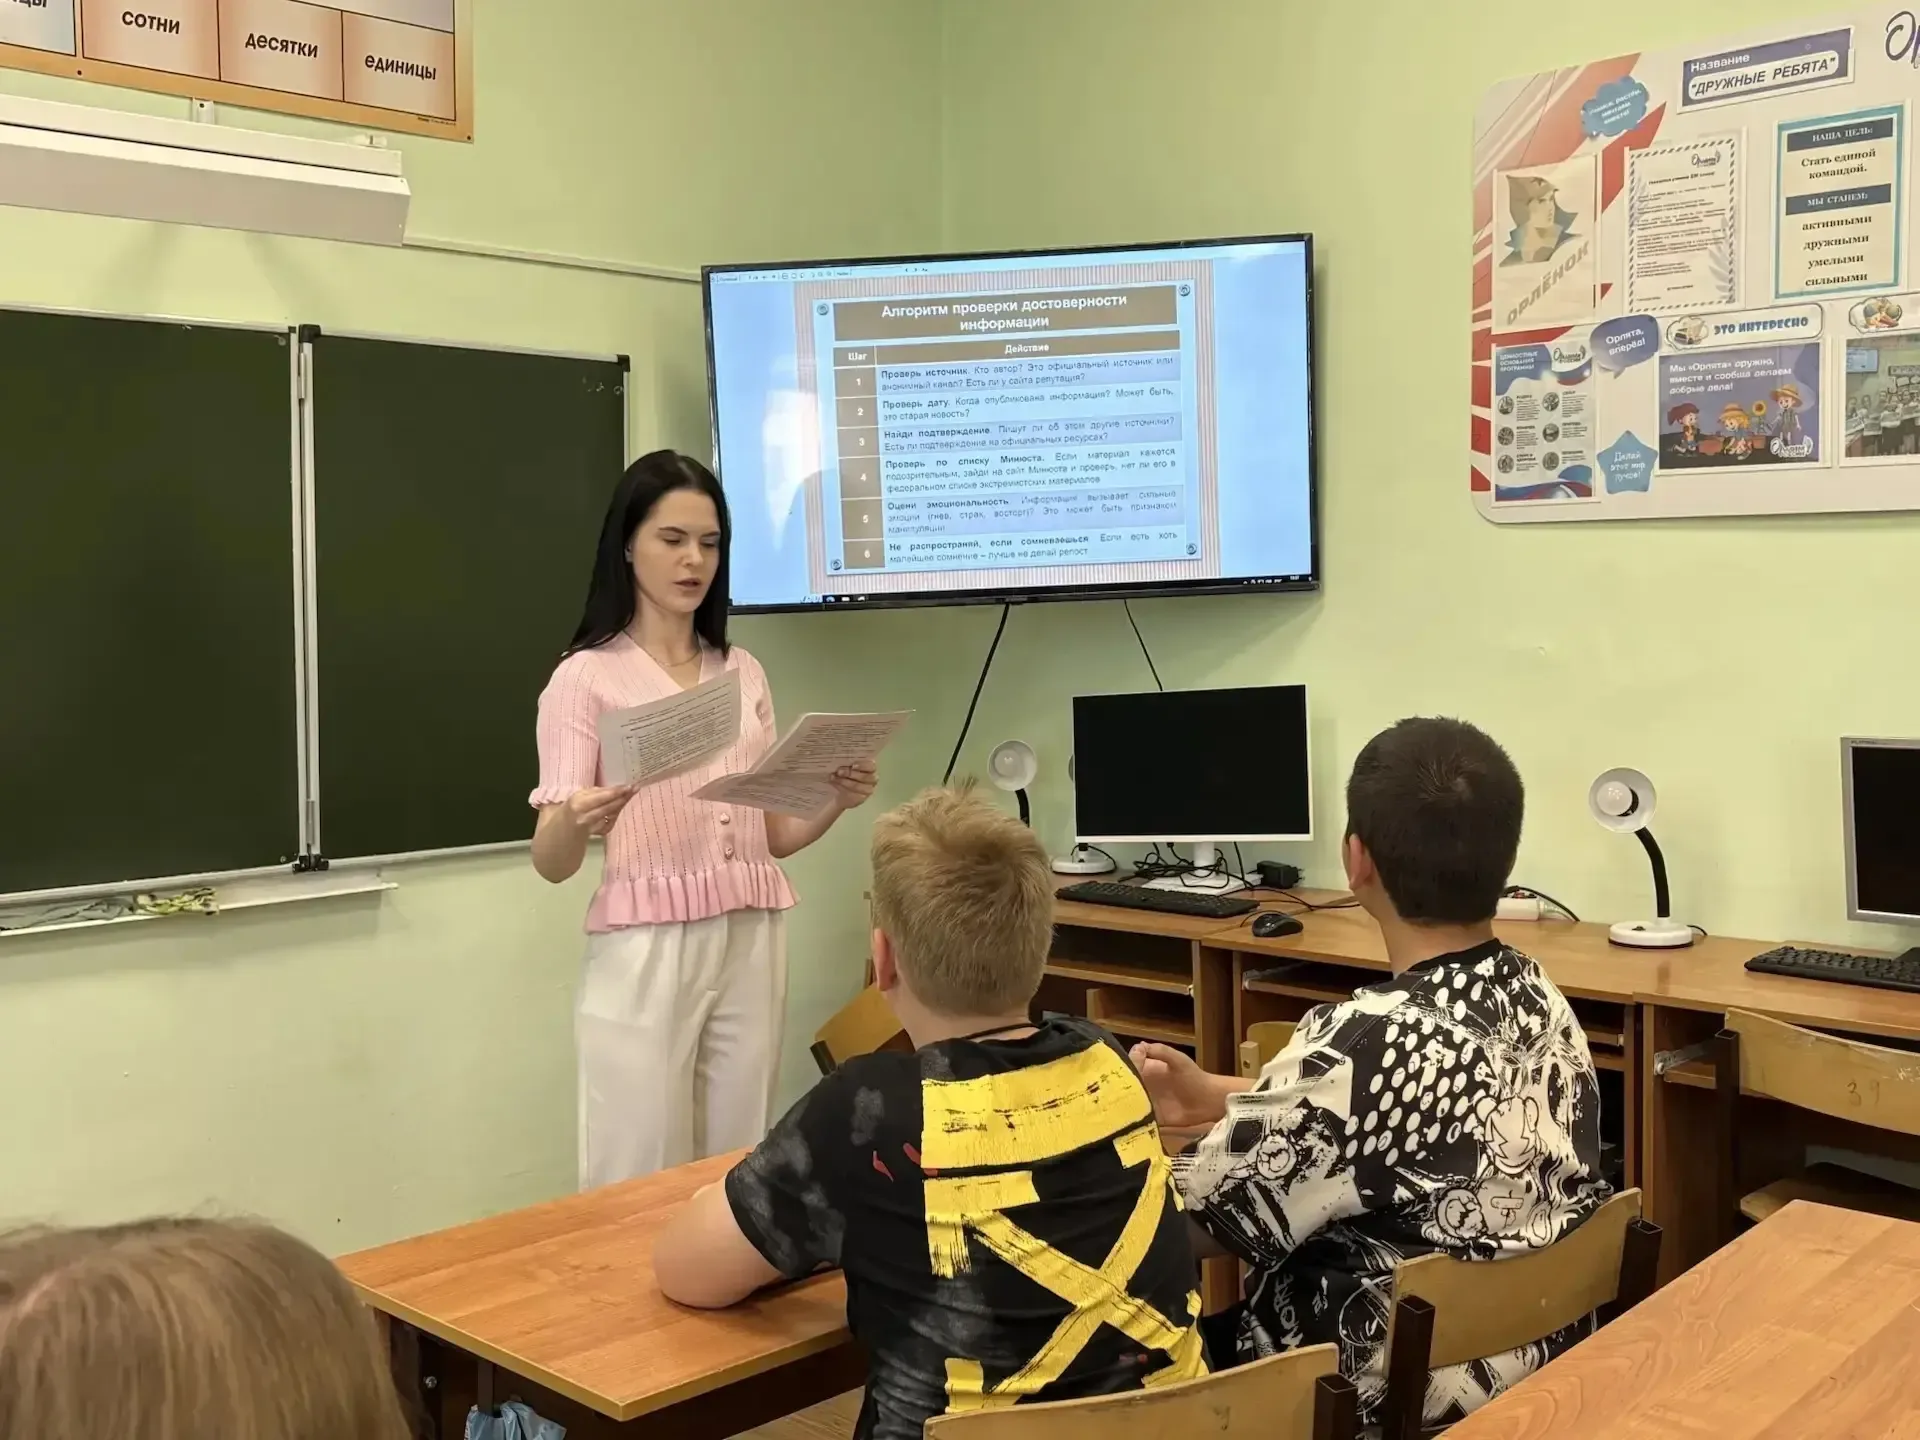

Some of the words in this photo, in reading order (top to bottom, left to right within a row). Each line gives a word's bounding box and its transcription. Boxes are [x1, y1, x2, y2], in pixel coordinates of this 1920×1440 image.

[122, 11, 180, 34] сотни
[245, 32, 318, 59] десятки
[364, 53, 436, 81] единицы
[1691, 54, 1750, 73] Название
[1691, 71, 1766, 96] "ДРУЖНЫЕ
[1772, 57, 1836, 81] РЕБЯТА"
[1812, 130, 1841, 142] НАША
[1801, 154, 1832, 167] Стать
[1834, 149, 1876, 164] единой
[1808, 165, 1868, 180] командой.
[1807, 198, 1824, 207] МЫ
[1802, 214, 1872, 231] активными
[1803, 234, 1869, 251] дружными
[1807, 254, 1864, 270] умелыми
[1507, 241, 1589, 325] ОРЛЁНОК
[1805, 273, 1868, 287] сильными
[881, 303, 948, 319] Алгоритм
[952, 301, 1018, 317] проверки
[1021, 294, 1127, 312] достоверности
[959, 315, 1049, 333] информации
[1713, 324, 1736, 335] ЭТО
[1738, 316, 1809, 333] ИНТЕРЕСНО
[1605, 328, 1645, 345] Орлята,
[848, 351, 867, 361] Шаг
[1004, 343, 1049, 355] Действие
[1608, 338, 1646, 357] вперёд!
[881, 371, 921, 379] Проверь
[993, 364, 1022, 373] автор?
[1027, 363, 1043, 371] Это
[1047, 359, 1109, 371] официальный
[1669, 363, 1686, 373] Мы
[881, 381, 930, 391] анонимный
[933, 379, 963, 388] канал?
[1008, 376, 1032, 384] сайта
[1035, 373, 1085, 384] репутация?
[1669, 374, 1704, 384] вместе
[1705, 374, 1712, 382] и
[882, 401, 922, 410] Проверь
[955, 397, 979, 405] Когда
[984, 395, 1044, 404] опубликована
[1049, 390, 1110, 401] информация?
[857, 407, 863, 415] 2
[899, 412, 929, 420] старая
[931, 409, 969, 418] новость?
[884, 431, 912, 439] Найди
[998, 425, 1025, 433] Пишут
[1048, 422, 1059, 430] об
[1090, 421, 1119, 429] другие
[1124, 417, 1174, 426] источники?
[859, 437, 864, 445] 3
[919, 440, 986, 450] подтверждение
[1002, 436, 1061, 446] официальных
[1064, 432, 1107, 443] ресурсах?
[885, 461, 925, 469] Проверь
[1055, 452, 1076, 460] Если
[860, 473, 866, 481] 4
[963, 469, 988, 477] зайди
[1005, 466, 1024, 474] сайт
[886, 484, 945, 493] федеральном
[887, 502, 916, 511] Оцени
[1020, 495, 1077, 504] Информация
[1087, 492, 1128, 500] вызывает
[862, 515, 868, 523] 5
[889, 554, 934, 562] малейшее
[1030, 547, 1056, 557] делай
